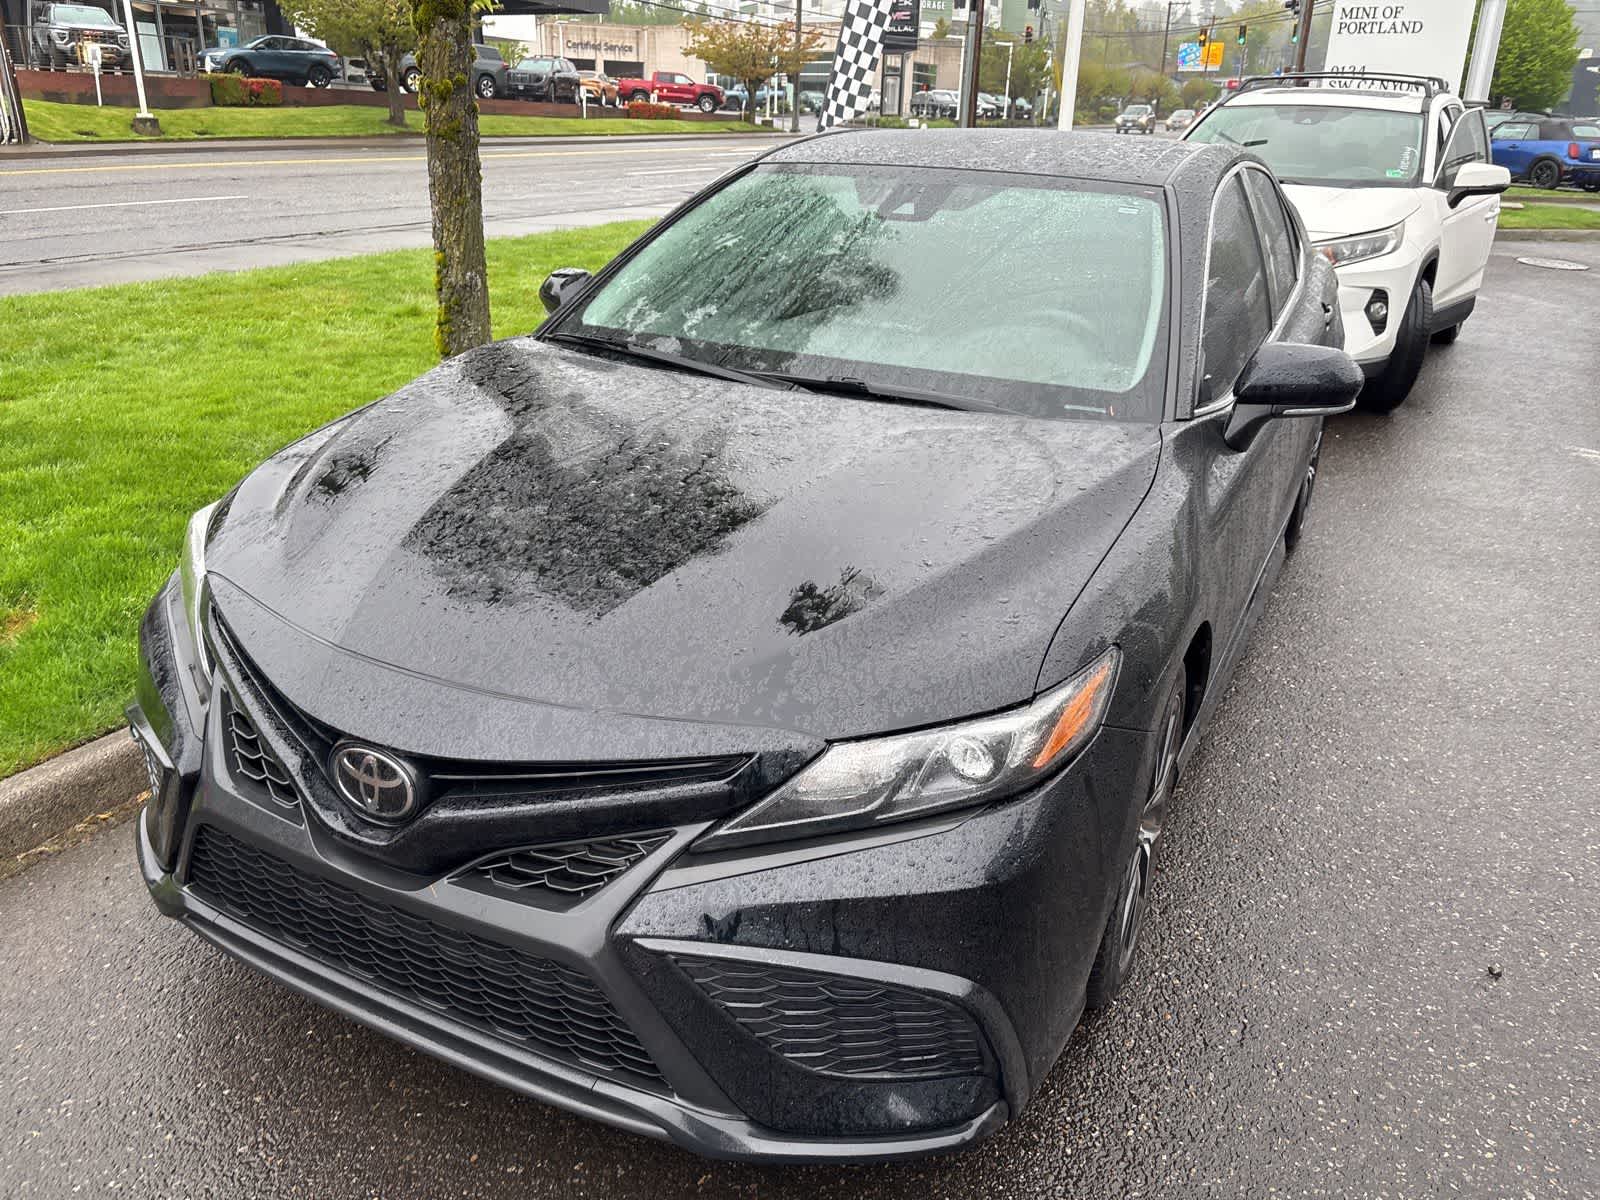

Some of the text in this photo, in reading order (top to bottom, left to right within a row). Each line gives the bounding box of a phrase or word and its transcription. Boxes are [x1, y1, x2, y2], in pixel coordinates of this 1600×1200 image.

[1340, 6, 1404, 20] MINI OF
[1337, 20, 1423, 34] PORTLAND
[566, 40, 632, 53] Certified Service
